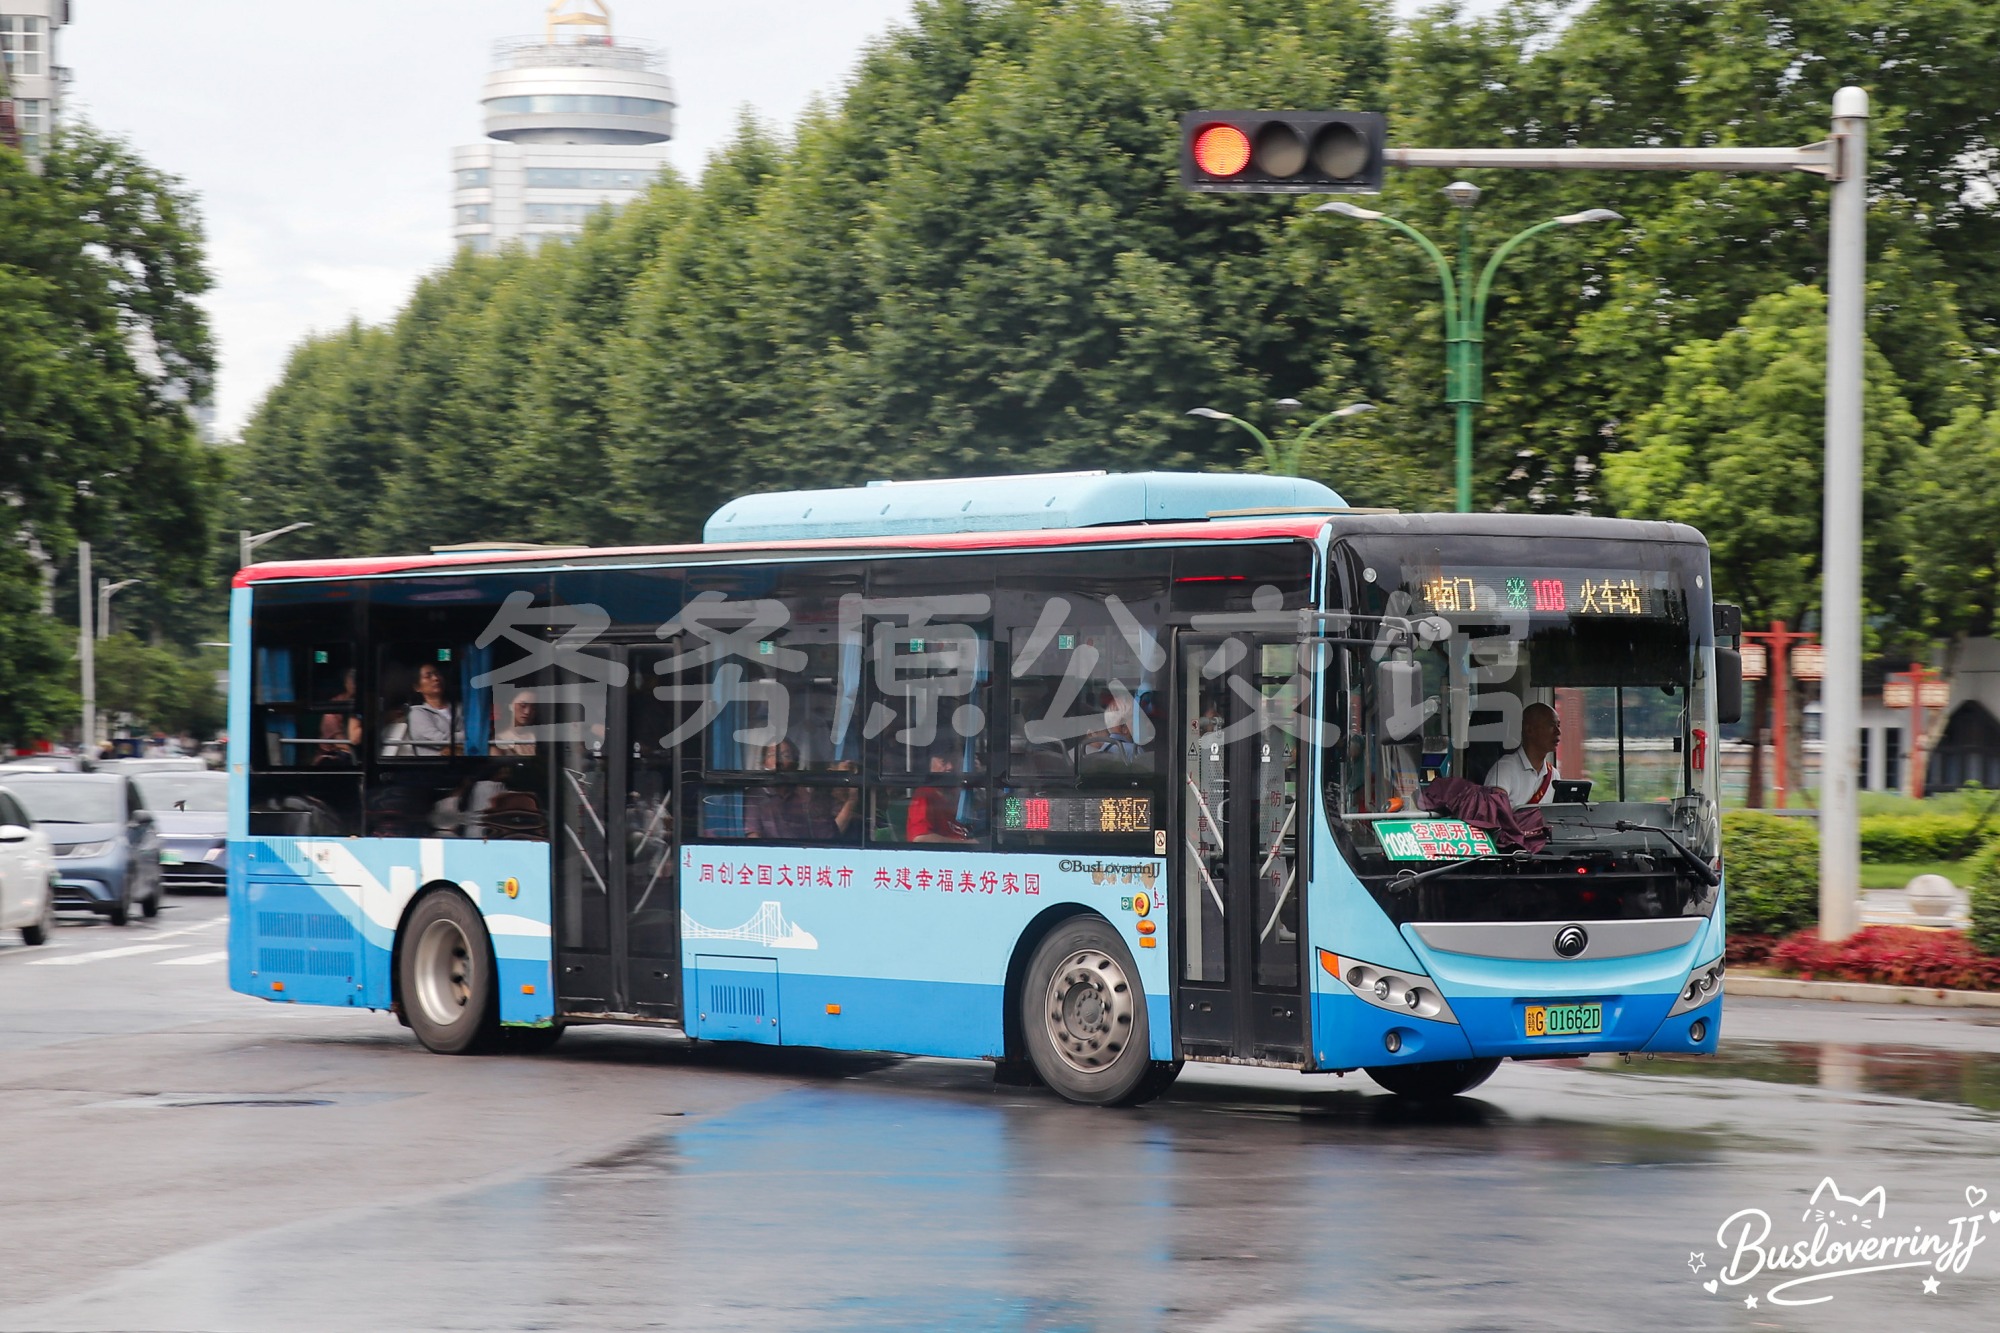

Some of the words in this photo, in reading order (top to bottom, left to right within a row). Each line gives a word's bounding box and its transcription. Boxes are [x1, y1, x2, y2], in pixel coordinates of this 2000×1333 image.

[1533, 579, 1566, 611] 108
[1580, 578, 1642, 613] 火车站
[1024, 799, 1050, 829] 108
[699, 862, 854, 888] 同创全国文明城市
[873, 867, 1040, 896] 共建幸福美好家园
